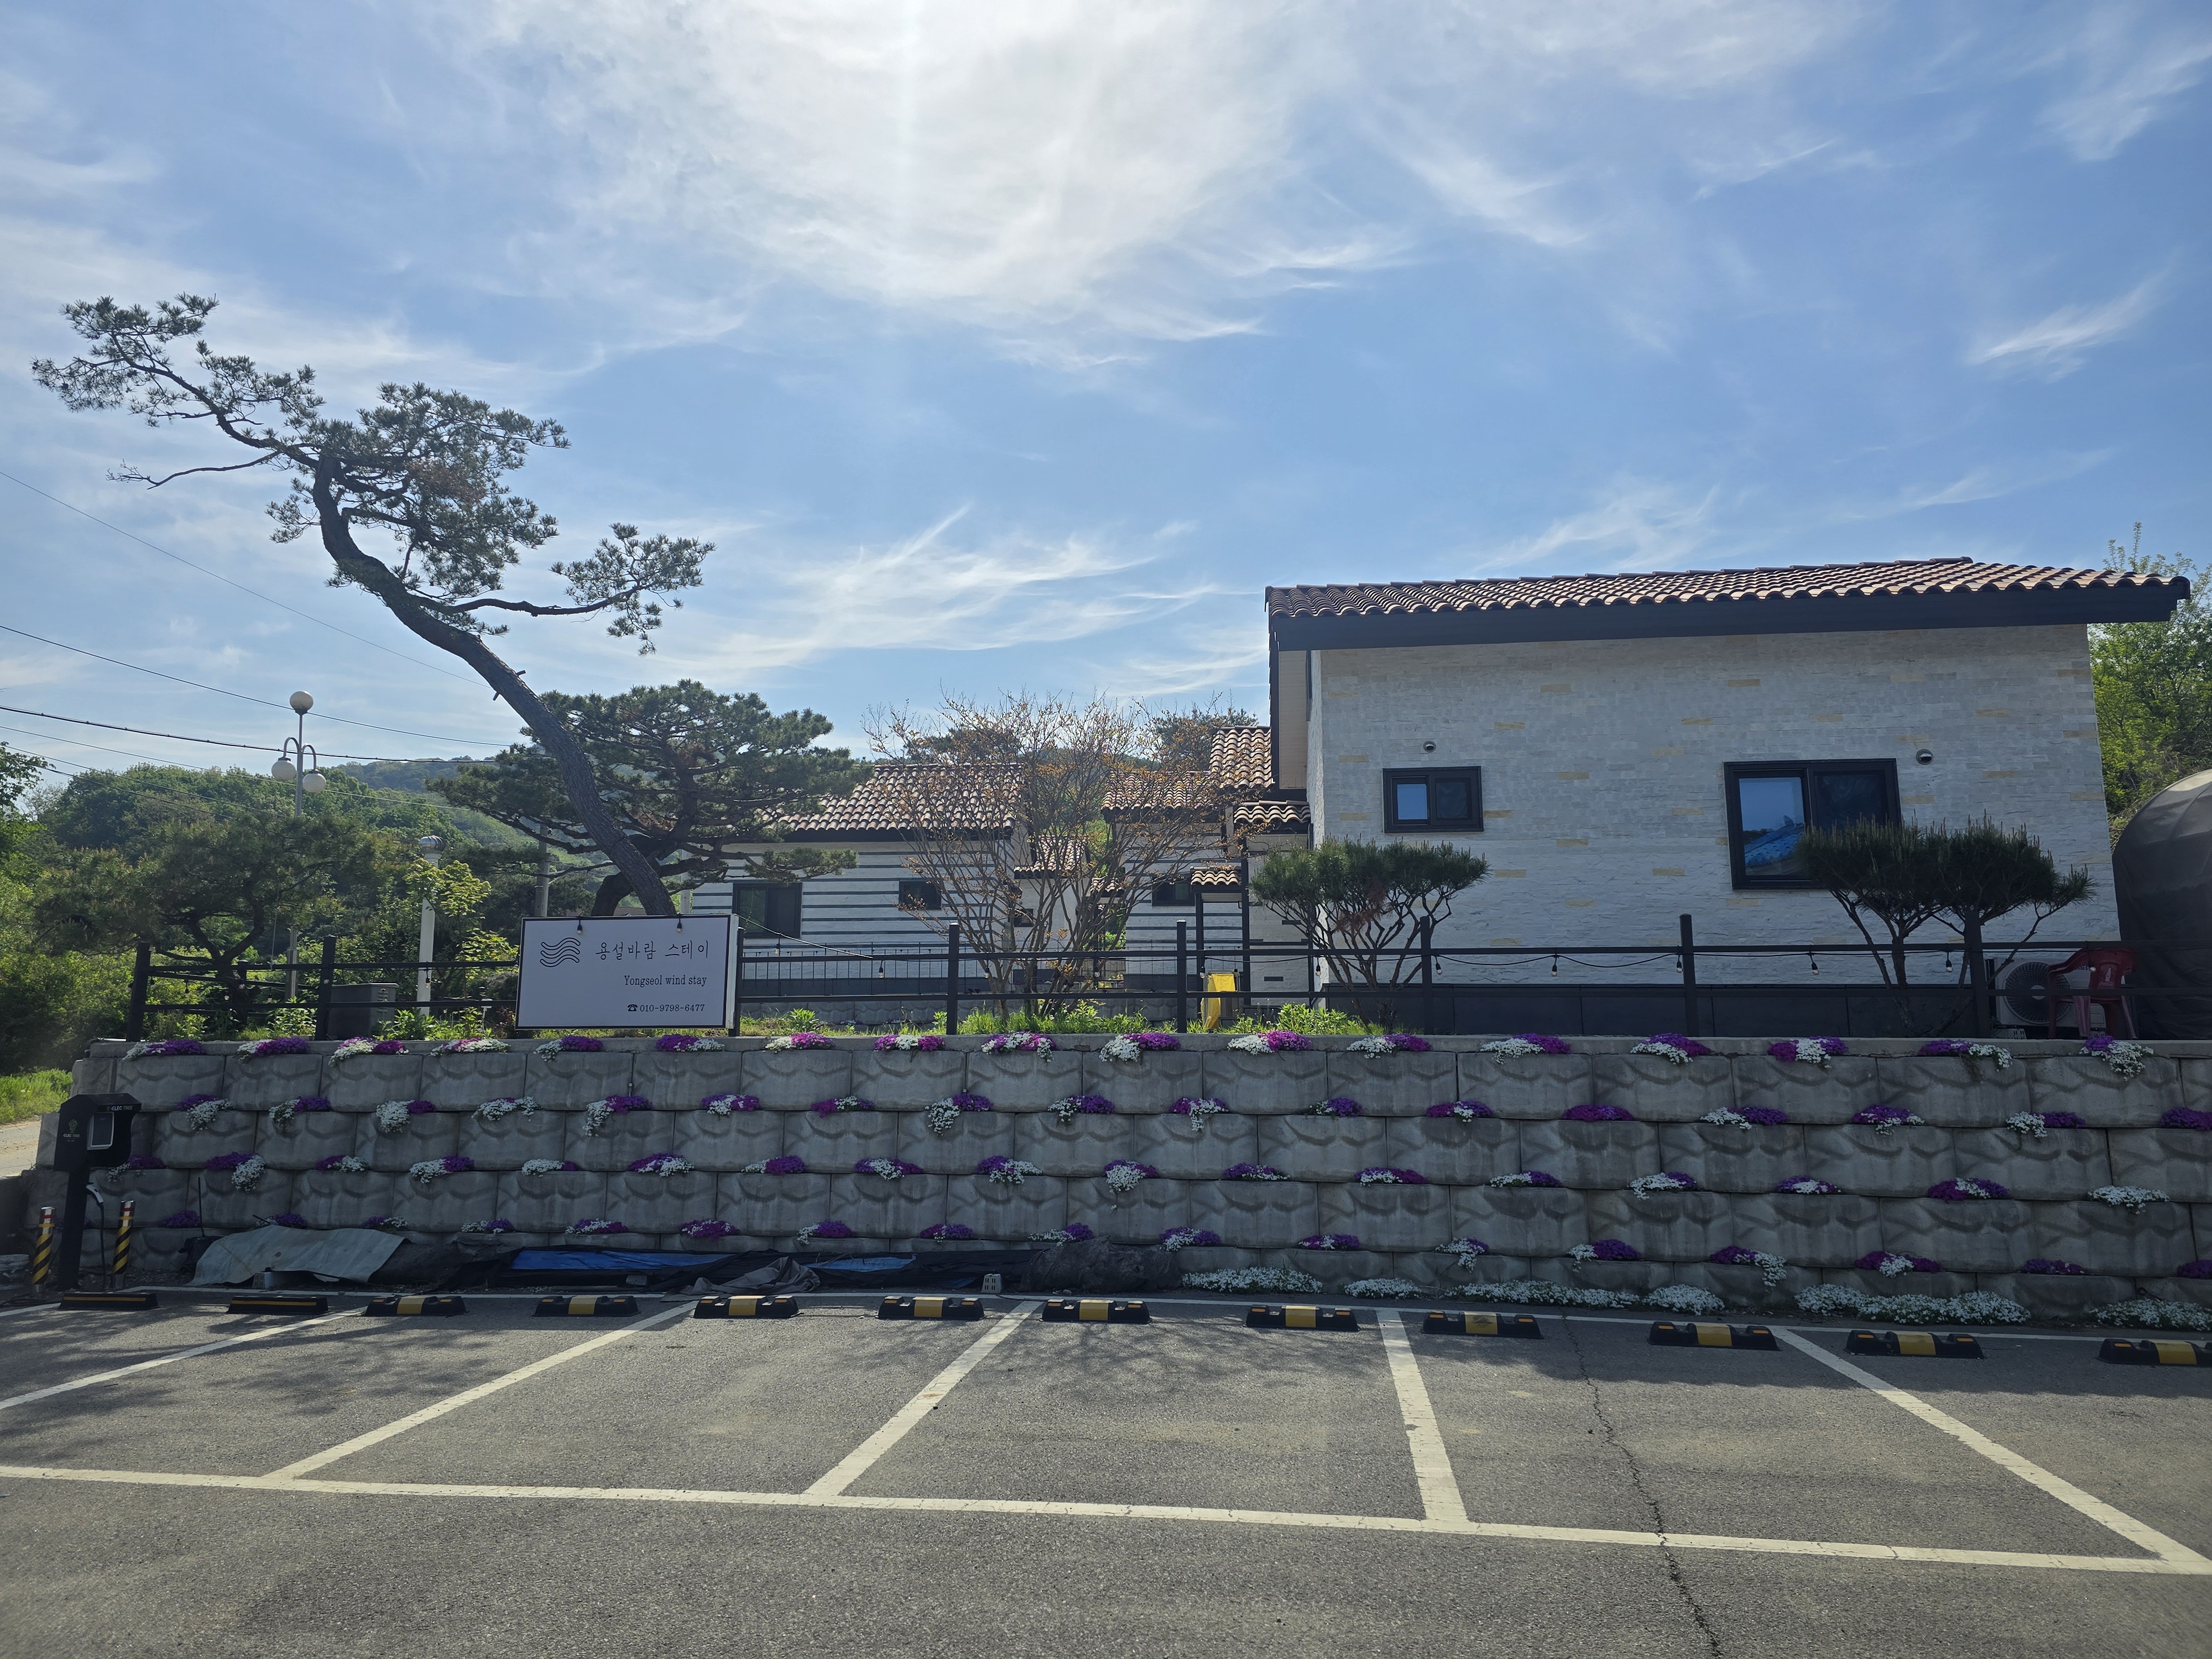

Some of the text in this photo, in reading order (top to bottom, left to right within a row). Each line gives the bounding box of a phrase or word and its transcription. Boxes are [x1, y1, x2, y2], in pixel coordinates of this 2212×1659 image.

[596, 940, 708, 960] 용설바람 스테이
[624, 974, 707, 988] Yongseol wind stay
[640, 1004, 705, 1012] 010-9798-6477
